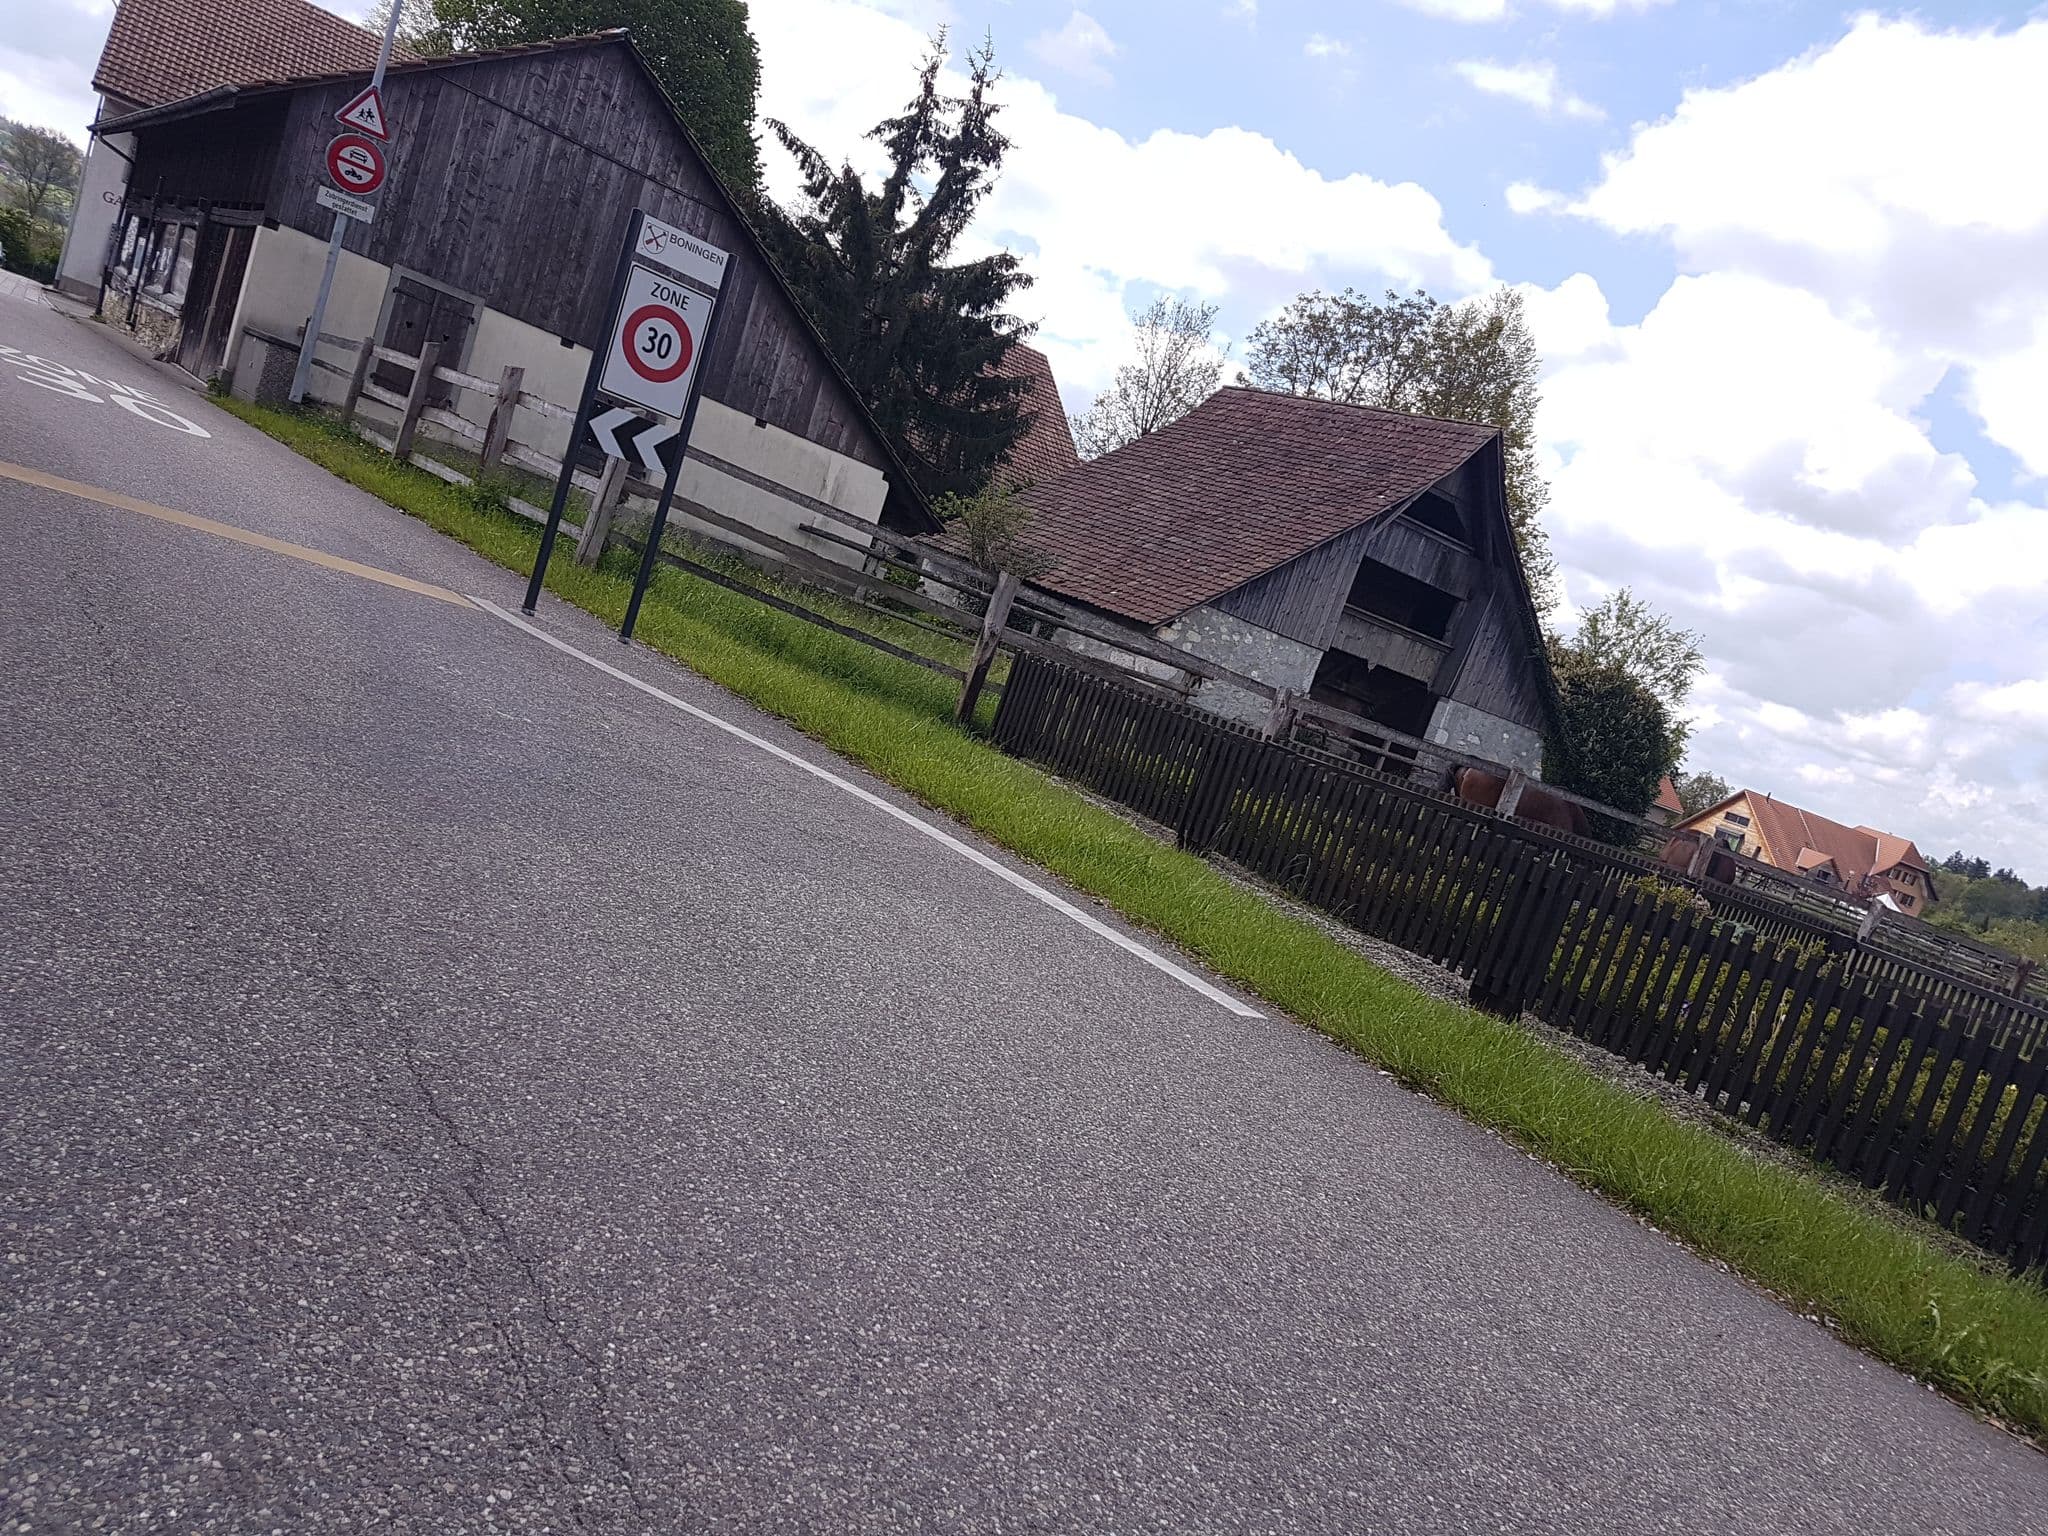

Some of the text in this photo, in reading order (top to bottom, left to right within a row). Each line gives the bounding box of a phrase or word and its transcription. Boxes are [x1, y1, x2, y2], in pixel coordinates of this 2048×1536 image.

[669, 233, 724, 266] BONINGEN
[650, 281, 690, 311] ZONE
[641, 326, 672, 359] 30
[0, 356, 212, 438] 30
